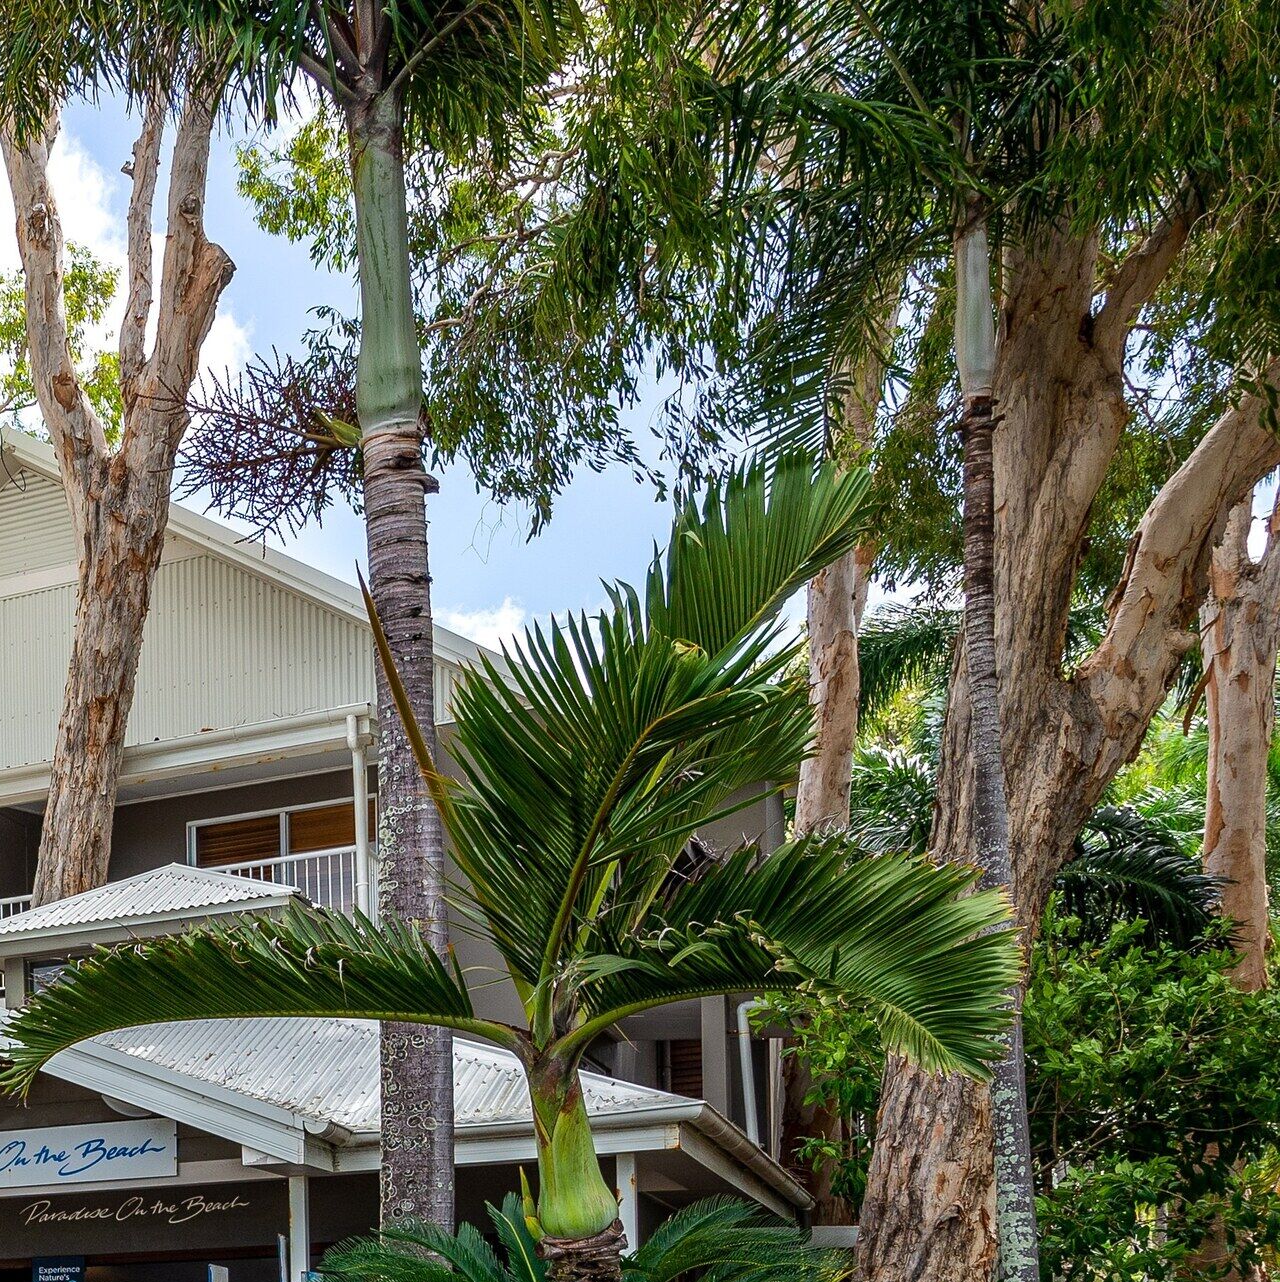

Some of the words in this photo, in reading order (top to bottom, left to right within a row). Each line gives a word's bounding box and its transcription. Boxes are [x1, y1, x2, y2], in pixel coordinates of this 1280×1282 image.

[34, 1144, 70, 1165] the
[58, 1138, 166, 1176] Beach
[20, 1200, 115, 1226] Paradise
[115, 1197, 148, 1222] On
[150, 1200, 179, 1215] the
[169, 1195, 249, 1224] Beach
[38, 1266, 80, 1274] Experience
